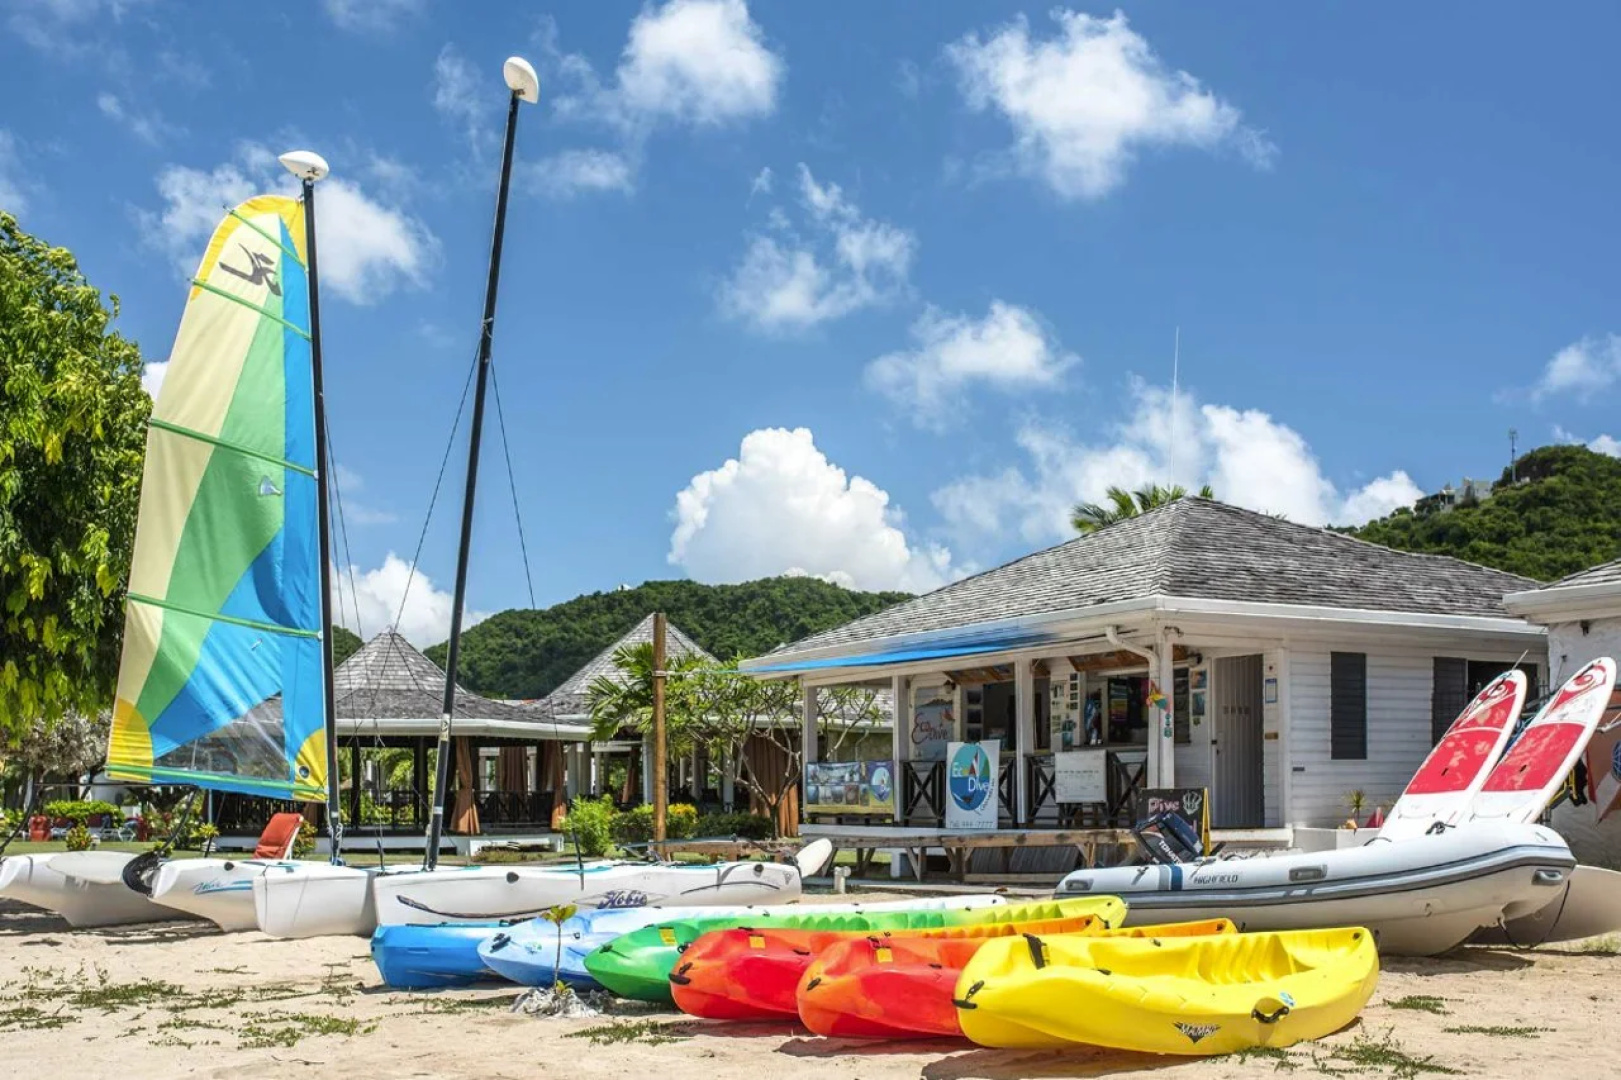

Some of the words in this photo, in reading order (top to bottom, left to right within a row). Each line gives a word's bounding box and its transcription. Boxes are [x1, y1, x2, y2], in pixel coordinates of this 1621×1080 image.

[968, 776, 990, 792] Dive
[1148, 797, 1180, 814] Dive
[1193, 874, 1238, 885] HIGHFIELD
[597, 889, 648, 909] Hobie
